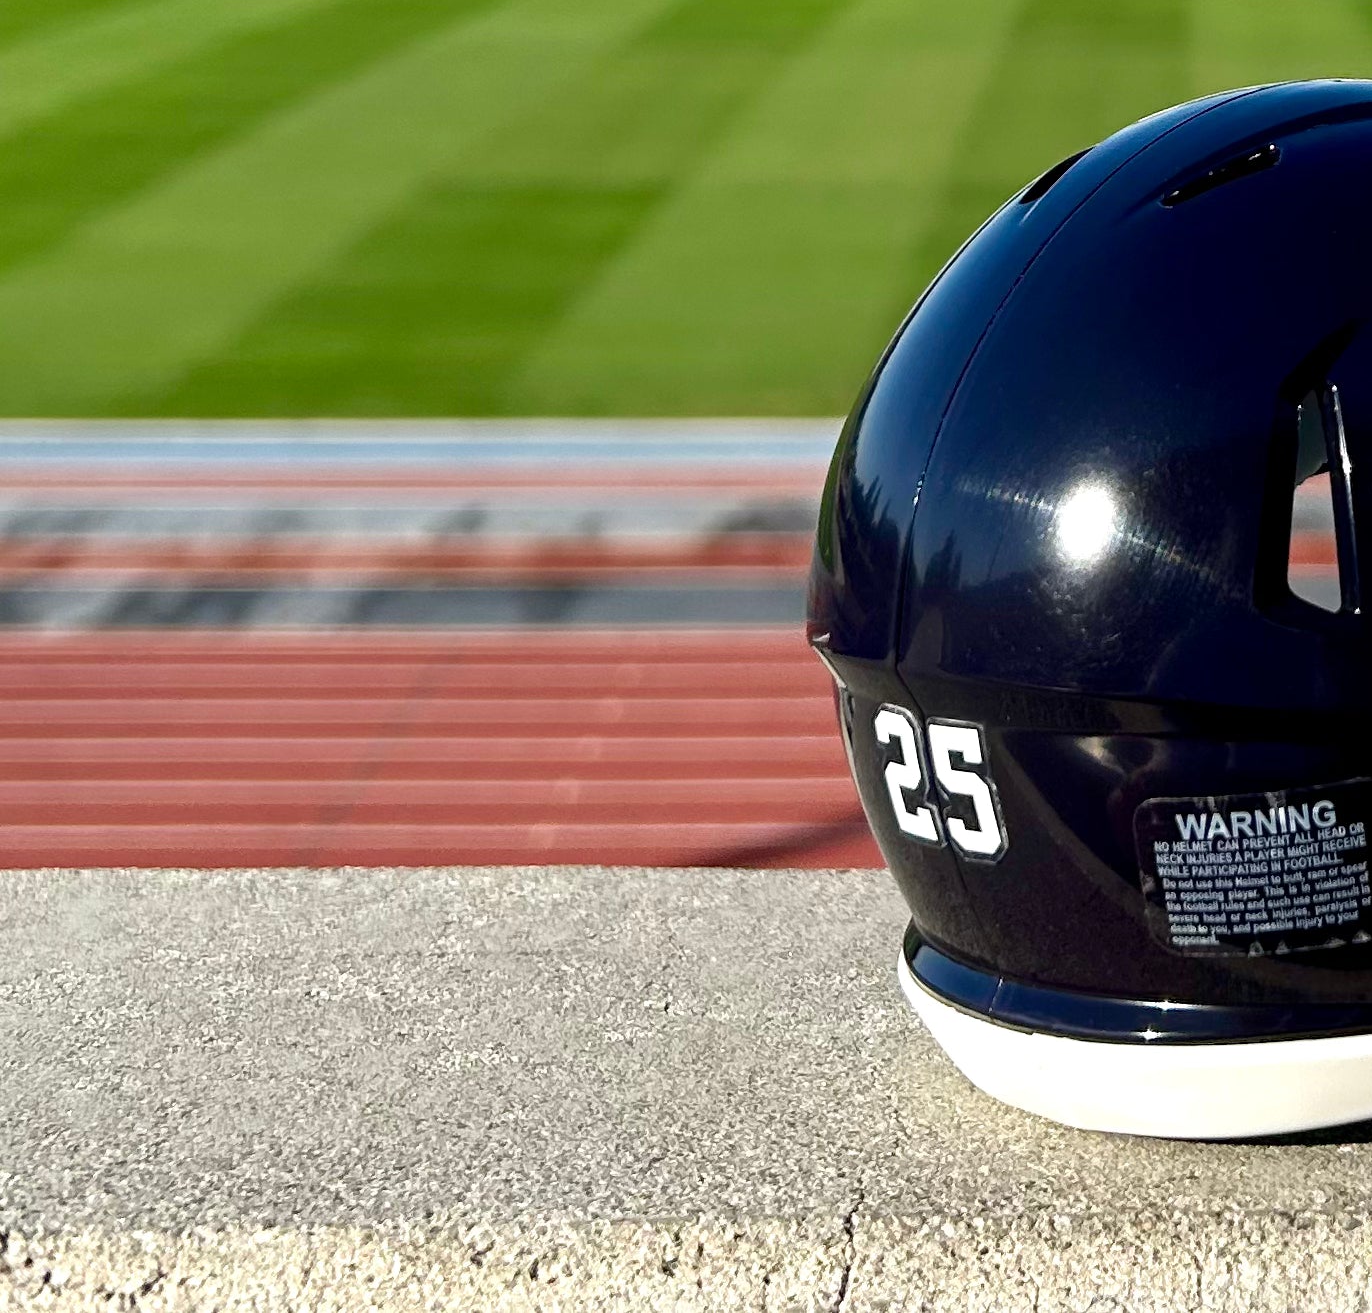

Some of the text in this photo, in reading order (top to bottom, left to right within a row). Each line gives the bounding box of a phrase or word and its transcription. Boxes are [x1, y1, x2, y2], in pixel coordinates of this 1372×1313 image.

[874, 702, 1009, 866] 25
[1175, 799, 1337, 840] WARNING
[1154, 821, 1365, 853] NO HELMET CAN PREVENT ALL HEAD OR
[1156, 835, 1367, 865] NECK INJURIES A PLAYER MIGHT RECEIVE
[1157, 852, 1344, 877] WHILE PARTICIPATING IN FOOTBALL.
[1163, 860, 1367, 890] Do not use this Helmet to butt, ram or spear
[1165, 870, 1370, 902] an opposing player. This is in violation of
[1166, 884, 1371, 912] the football rules and such use can result in
[1170, 910, 1359, 935] death to you, and possible injury to your
[1203, 912, 1227, 923] head
[1231, 912, 1241, 922] or
[1245, 909, 1269, 922] neck
[1315, 899, 1358, 916] paralysis
